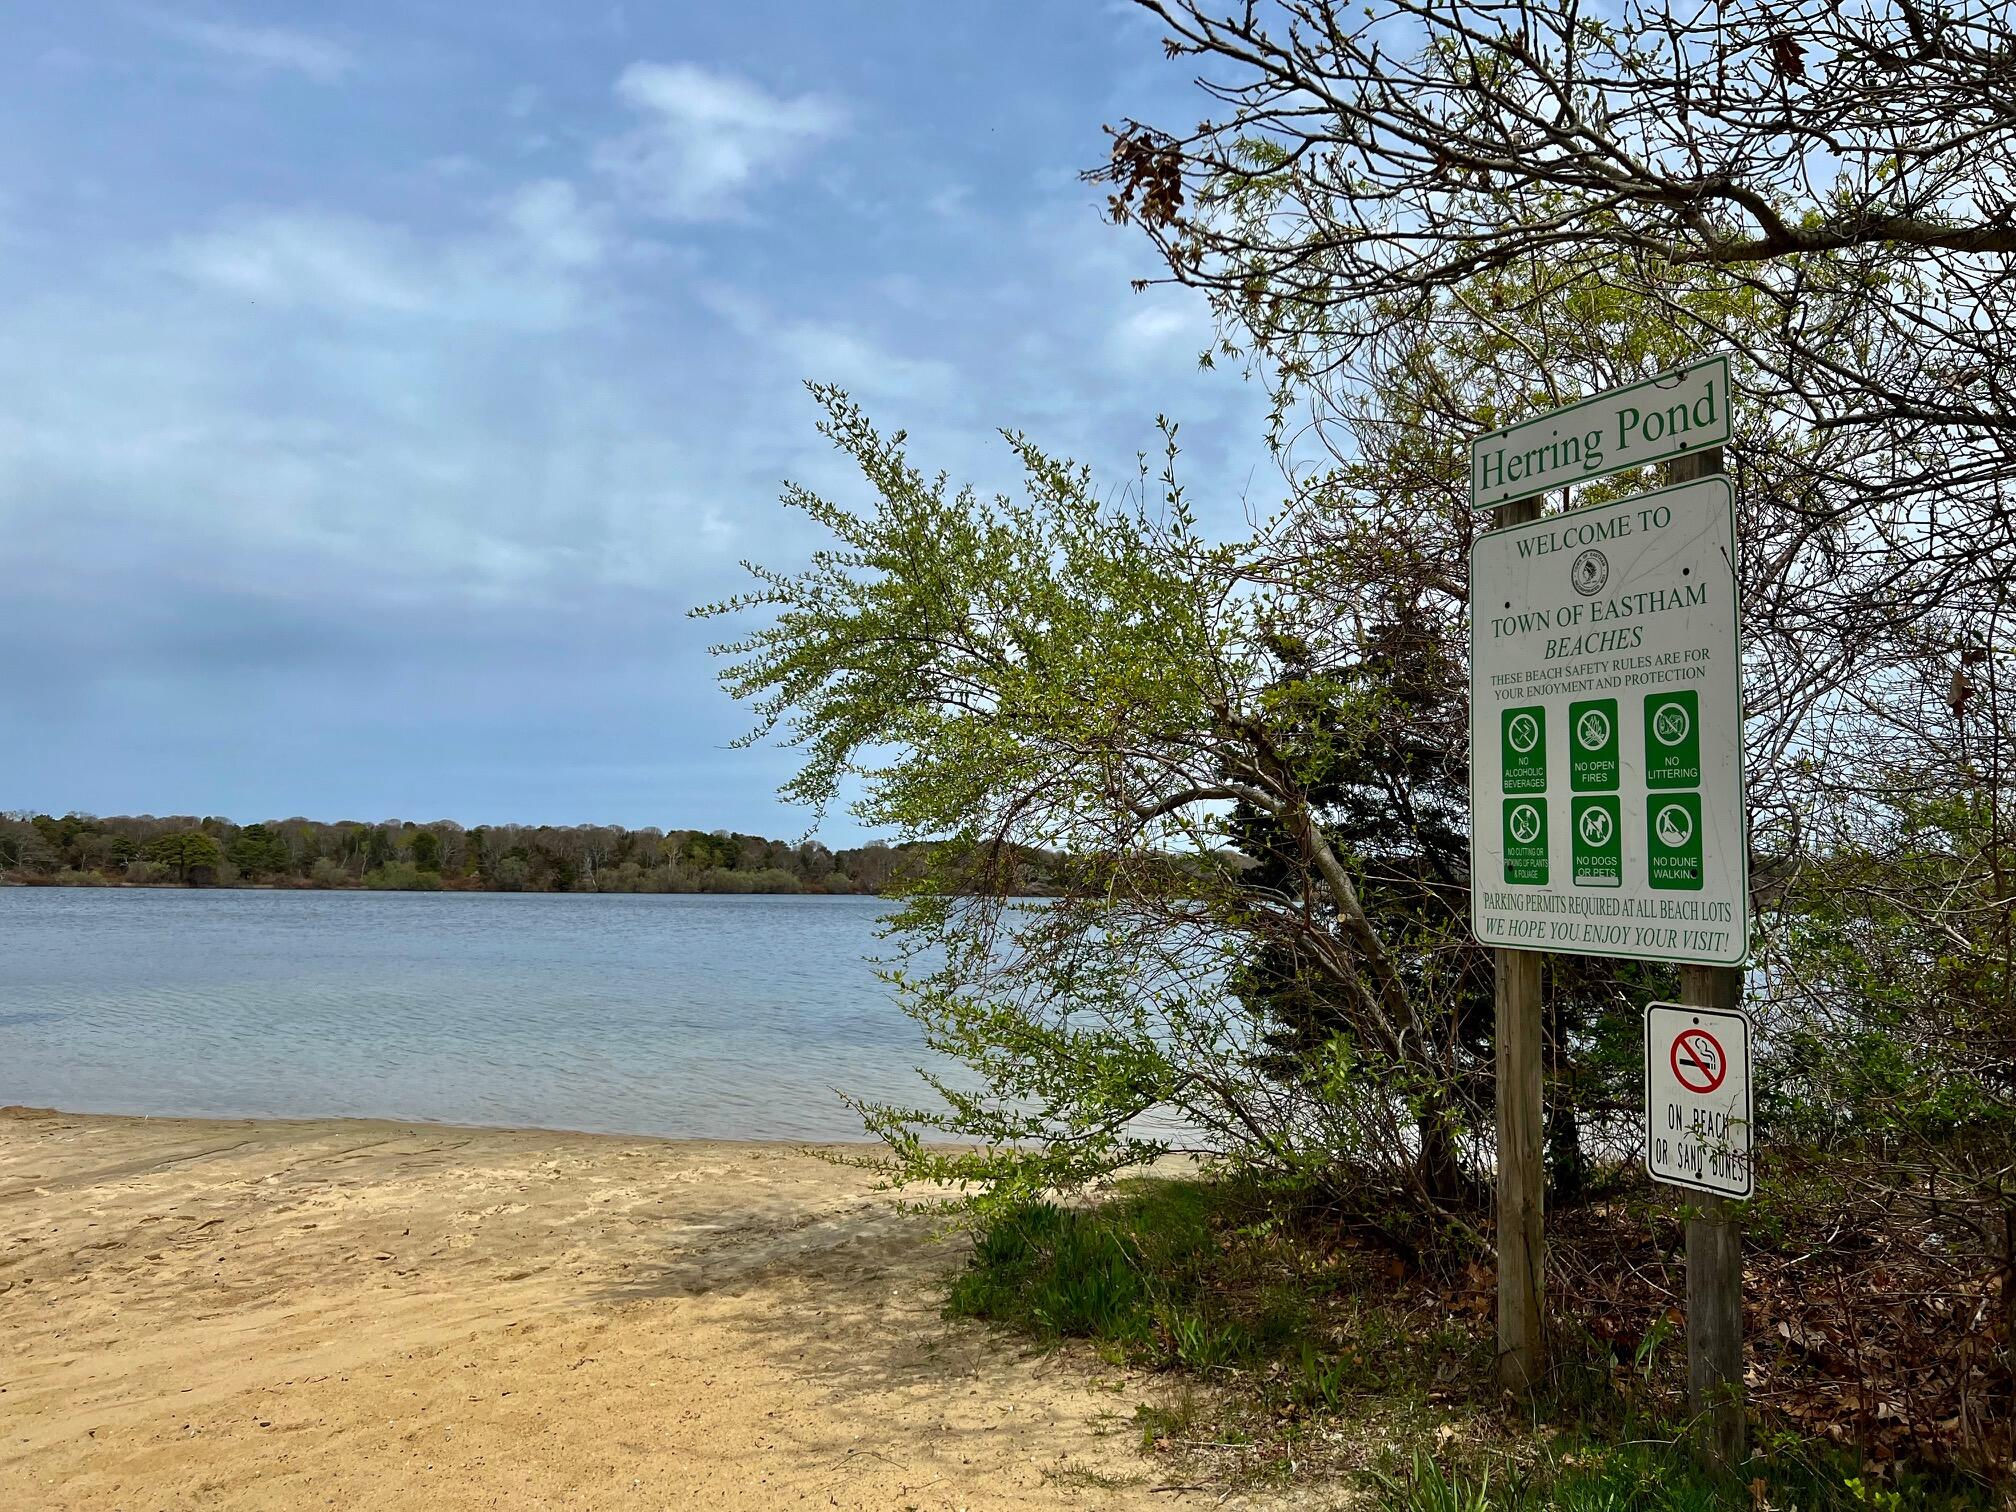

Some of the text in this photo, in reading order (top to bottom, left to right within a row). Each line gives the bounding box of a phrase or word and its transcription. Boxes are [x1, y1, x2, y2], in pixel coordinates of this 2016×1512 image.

[1480, 380, 1719, 491] Herring Pond
[1516, 506, 1671, 559] WELCOME TO
[1491, 582, 1708, 638] TOWN OF EASTHAM
[1544, 626, 1644, 660] BEACHES
[1491, 648, 1710, 686] THESE BEACH SAFETY RULES ARE FOR
[1494, 666, 1706, 700] YOUR ENJOYMENT AND PROTECTION
[1518, 757, 1529, 766] NO
[1574, 761, 1615, 771] NO OPEN
[1664, 756, 1680, 766] NO
[1505, 767, 1543, 778] ALCOHOLIC
[1582, 773, 1608, 783] FIRES
[1648, 768, 1698, 780] LITTERING
[1504, 778, 1545, 789] BEVERAGES
[1576, 856, 1617, 866] NO DOGS
[1653, 857, 1698, 867] NO DUNE
[1578, 868, 1616, 877] OR PETS
[1483, 892, 1731, 922] PARKING PERMITS REQUIRED AT ALL BEACH LOTS
[1486, 918, 1729, 952] WE HOPE YOU ENJOY YOUR VISIT!
[1668, 1103, 1729, 1140] ON BEACH
[1656, 1138, 1668, 1165] OR
[1678, 1142, 1702, 1172] SAND
